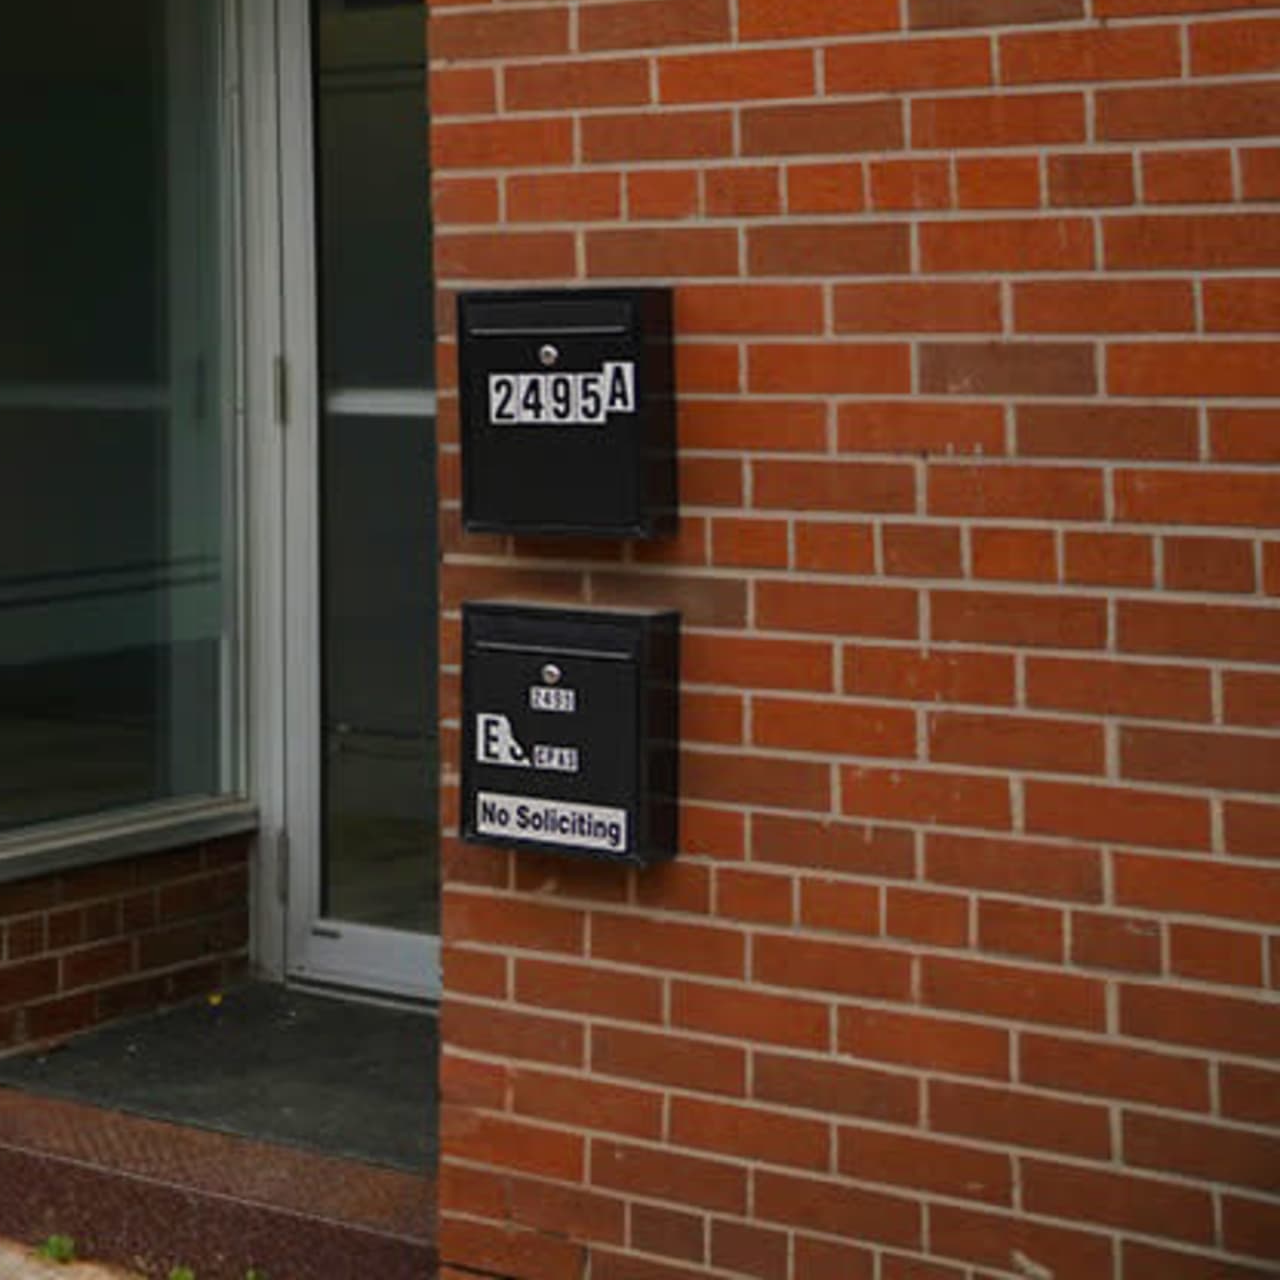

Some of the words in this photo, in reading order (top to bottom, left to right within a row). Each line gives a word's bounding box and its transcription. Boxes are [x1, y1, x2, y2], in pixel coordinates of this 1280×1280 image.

[493, 365, 630, 420] 2495A
[482, 801, 510, 827] No
[516, 805, 621, 847] Soliciting
